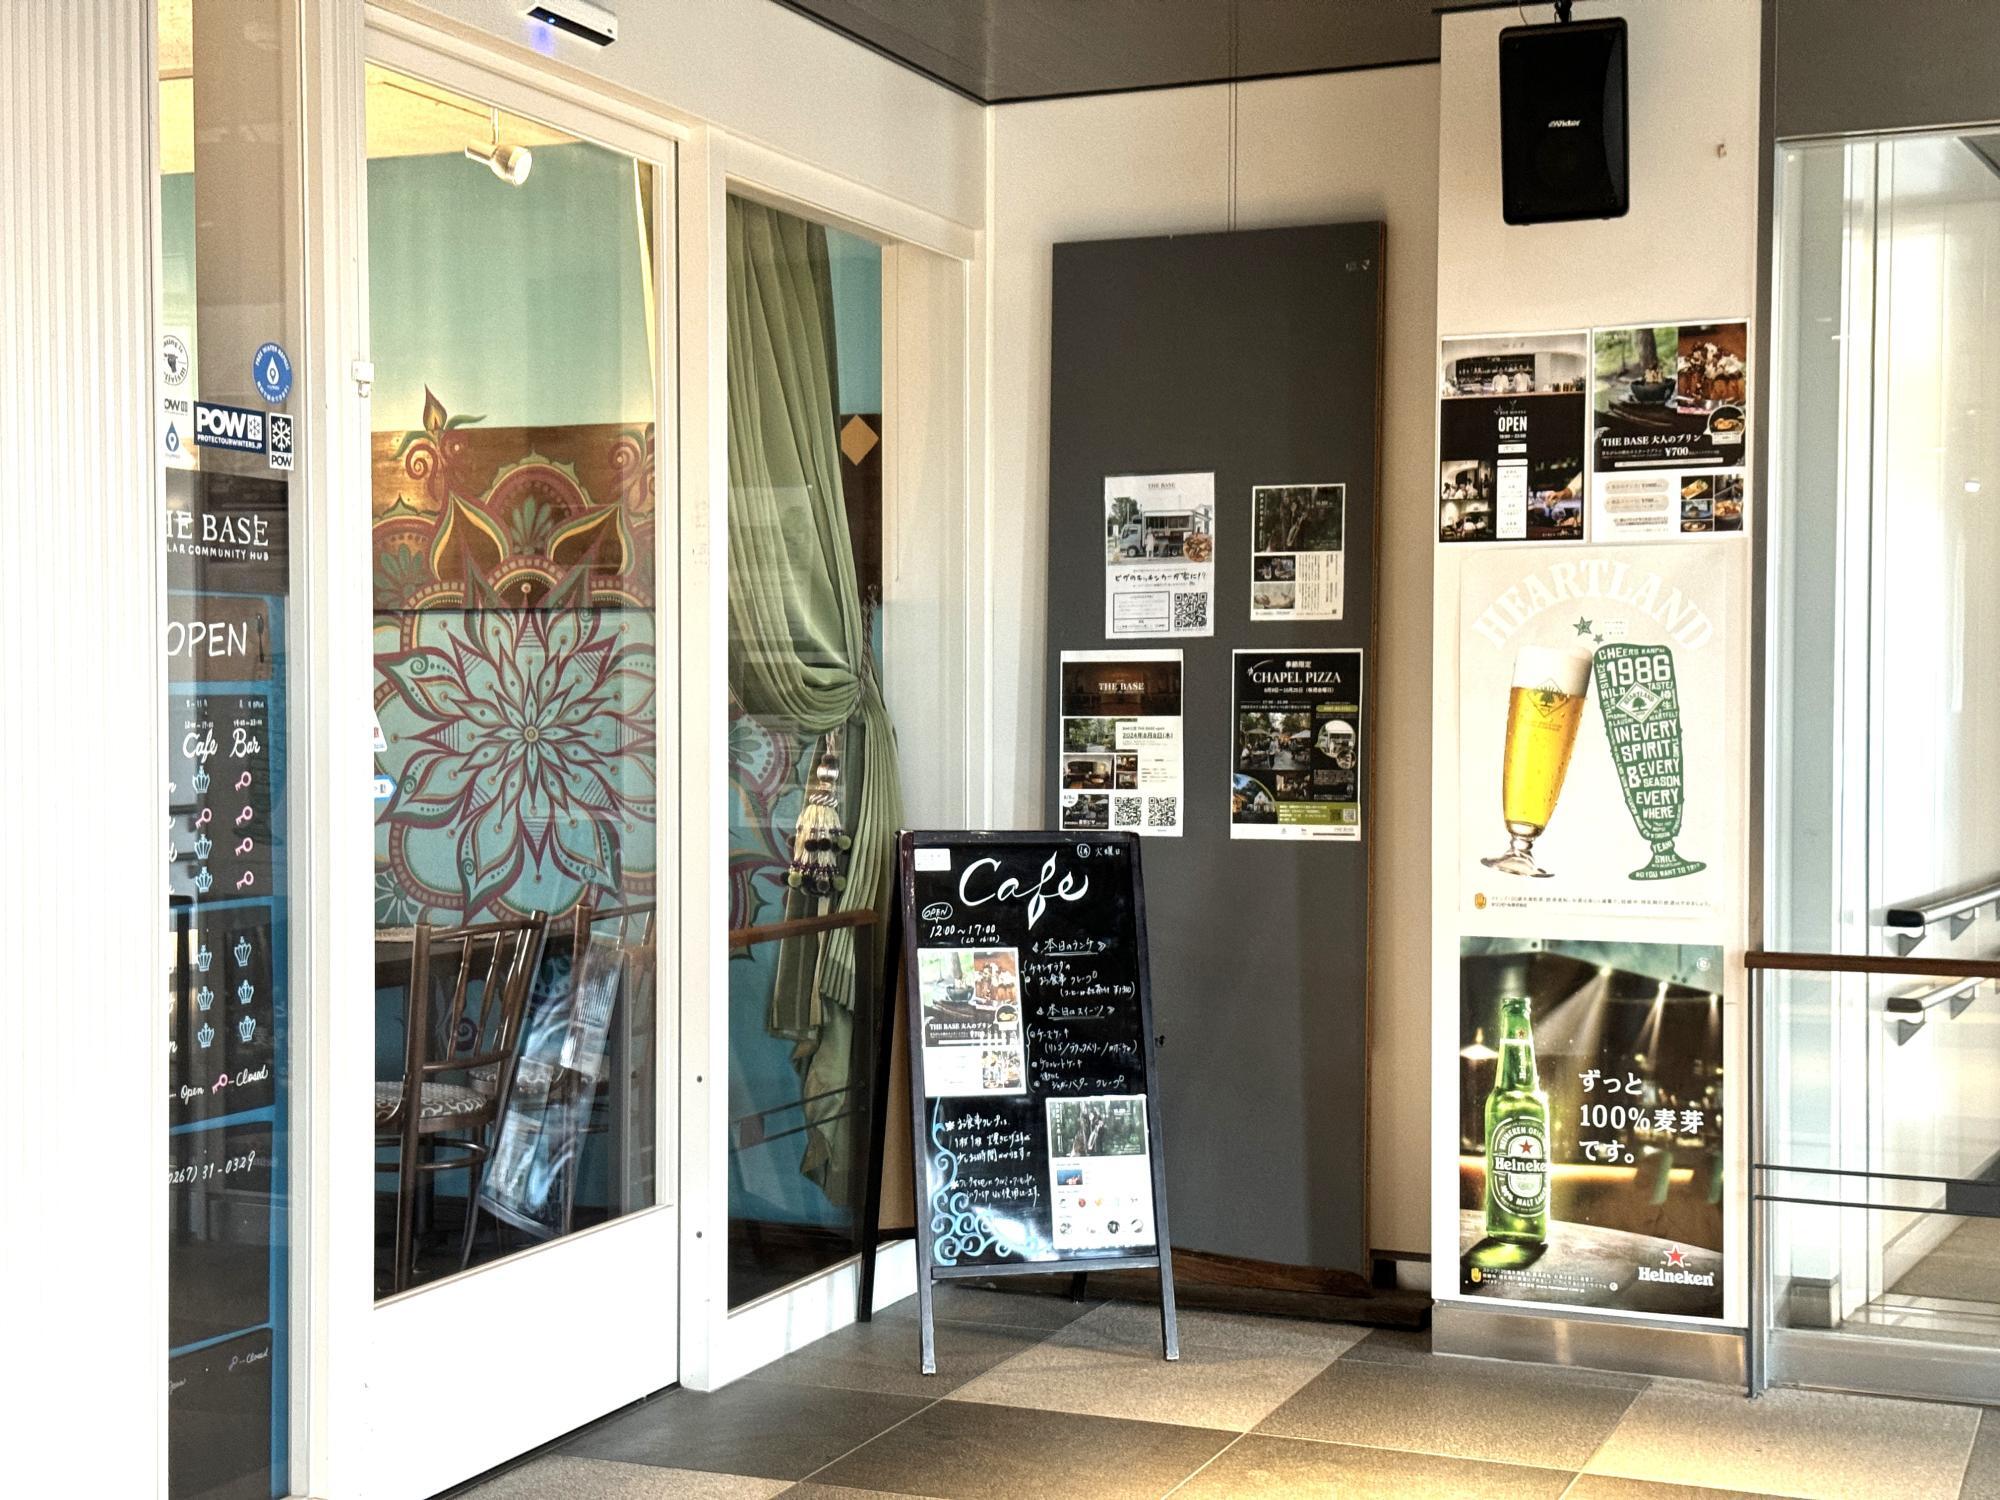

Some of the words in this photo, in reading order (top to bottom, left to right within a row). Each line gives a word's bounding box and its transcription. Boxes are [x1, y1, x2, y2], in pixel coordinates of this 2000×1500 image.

[196, 405, 252, 441] POW
[1498, 416, 1528, 433] OPEN
[197, 433, 263, 453] PROTECTOURWINTERS.JP
[1601, 437, 1622, 449] THE
[1623, 436, 1649, 447] BASE
[1651, 434, 1702, 445] 大人のプリン
[271, 455, 292, 467] POW
[1665, 446, 1689, 457] ¥700
[202, 513, 269, 546] BASE
[188, 544, 247, 561] COMMUNITY
[249, 550, 269, 561] HUB
[1470, 557, 1713, 652] HEARTLAND
[1598, 647, 1639, 661] CHEERS
[1252, 671, 1303, 684] CHAPEL
[1305, 671, 1342, 684] PIZZA
[1606, 654, 1672, 688] 1986
[1098, 682, 1118, 694] THE
[1120, 682, 1145, 694] BASE
[1600, 687, 1626, 700] MILD
[182, 728, 218, 764] Cafe
[229, 727, 261, 758] Bar
[1620, 739, 1671, 763] SPIRIT
[1626, 765, 1642, 789] &
[1638, 758, 1680, 777] EVERY
[1642, 775, 1682, 788] SEASON
[1636, 787, 1679, 806] EVERY
[1642, 805, 1675, 820] WHERE
[1654, 854, 1678, 864] SMILE
[959, 850, 1089, 932] Cafe
[924, 906, 949, 918] OPEN
[1578, 1067, 1644, 1097] ずっと
[1579, 1104, 1705, 1136] 100%麦芽
[1578, 1140, 1637, 1165] です。
[1637, 1265, 1715, 1289] Heineken
